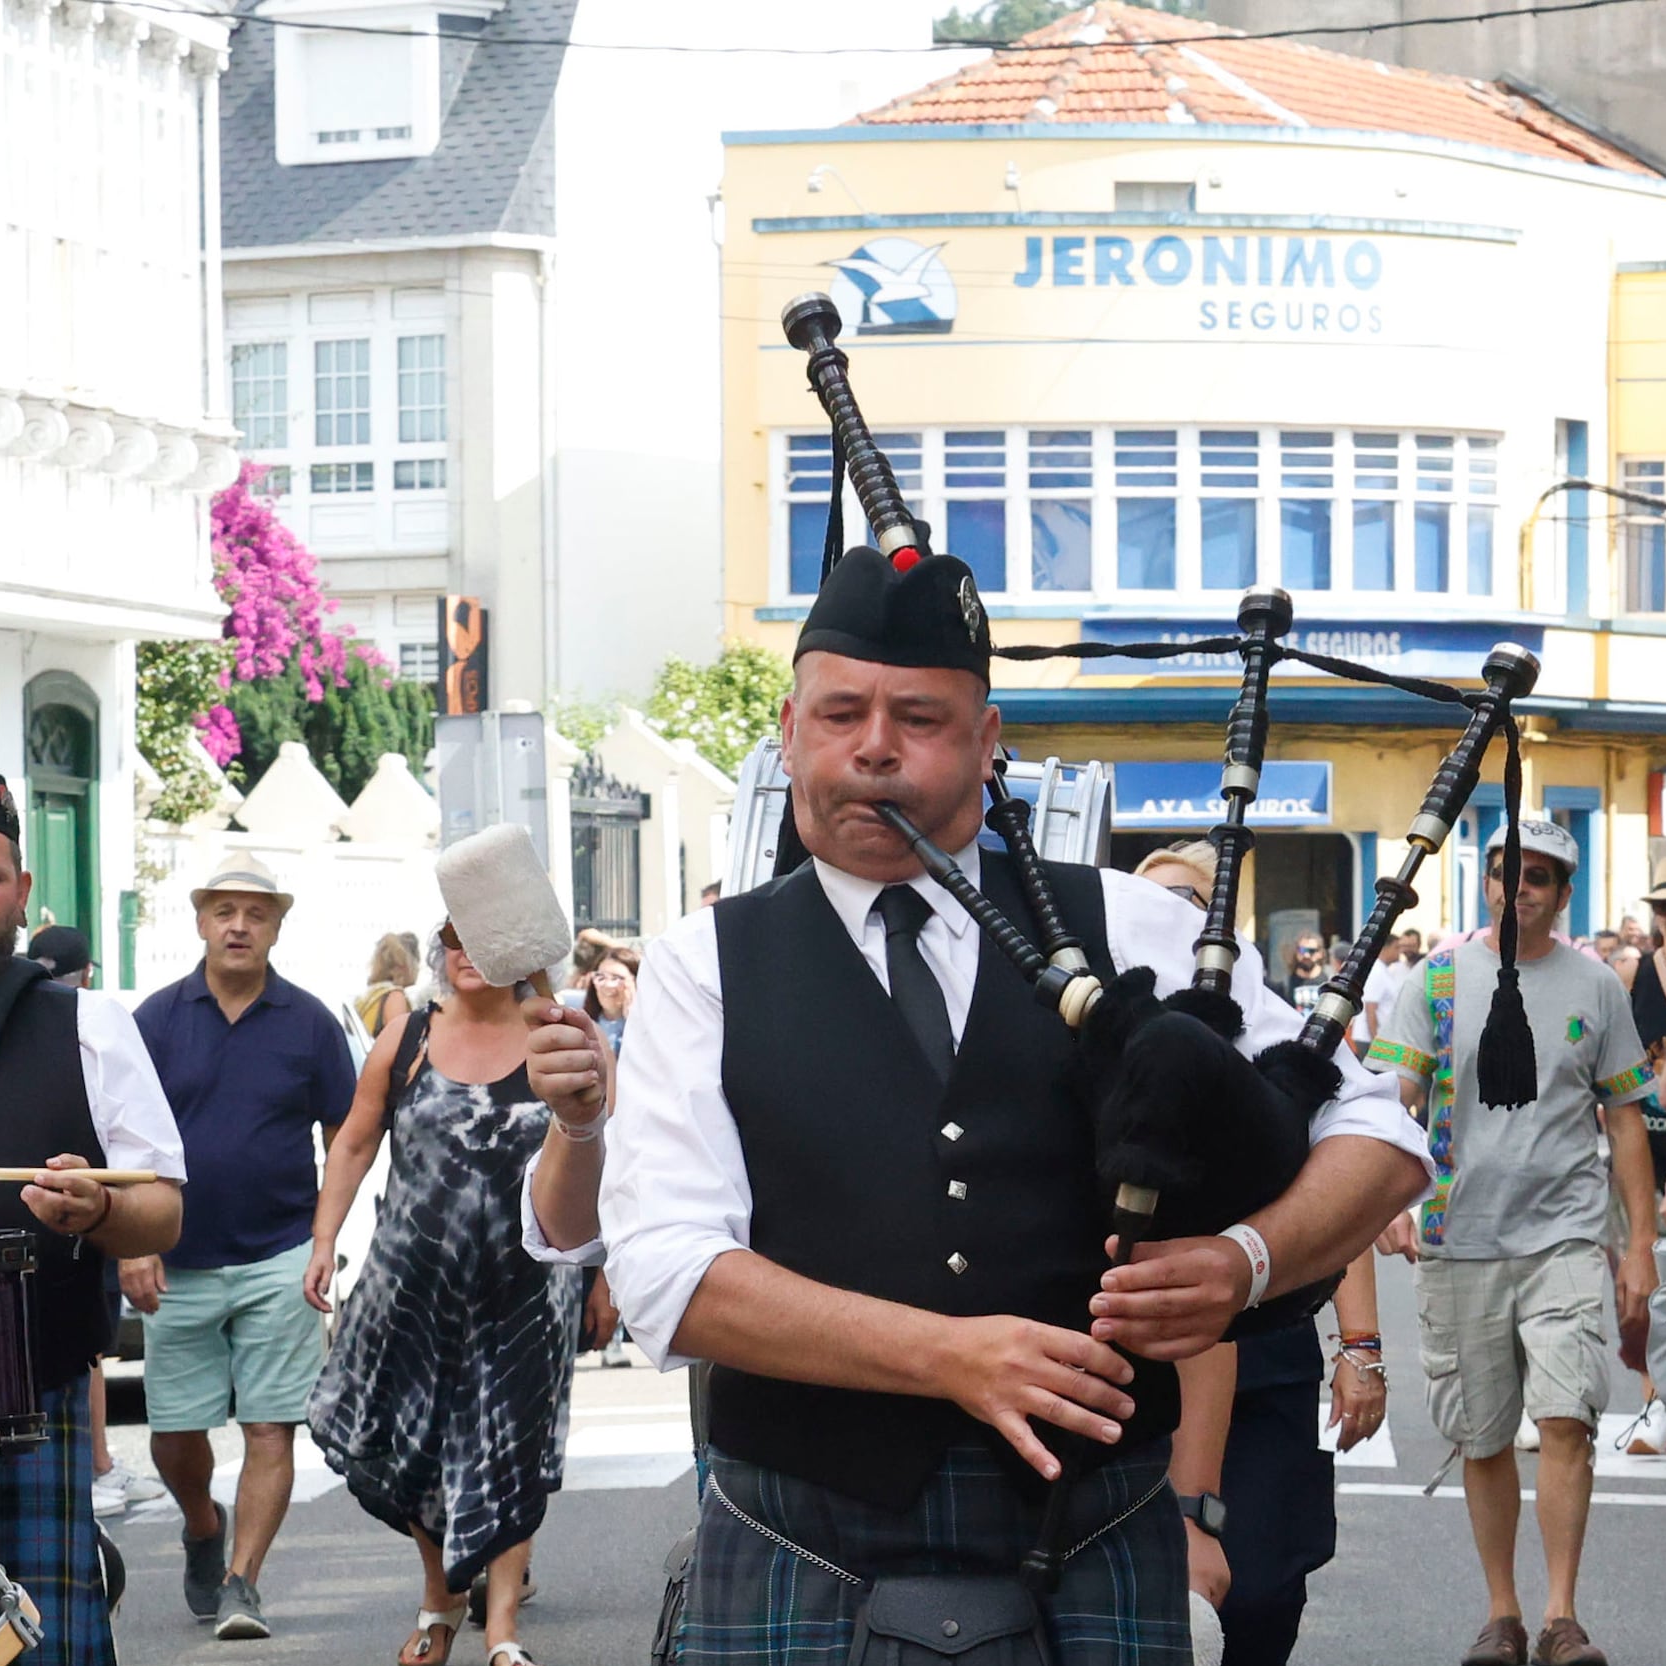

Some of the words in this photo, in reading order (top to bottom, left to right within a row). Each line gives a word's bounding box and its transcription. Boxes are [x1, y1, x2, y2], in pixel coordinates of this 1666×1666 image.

[1013, 234, 1383, 290] JERONIMO
[1198, 301, 1383, 333] SEGUROS
[1306, 631, 1402, 665] SEGUROS
[1141, 799, 1194, 815] AXA
[1206, 799, 1311, 815] SEUROS
